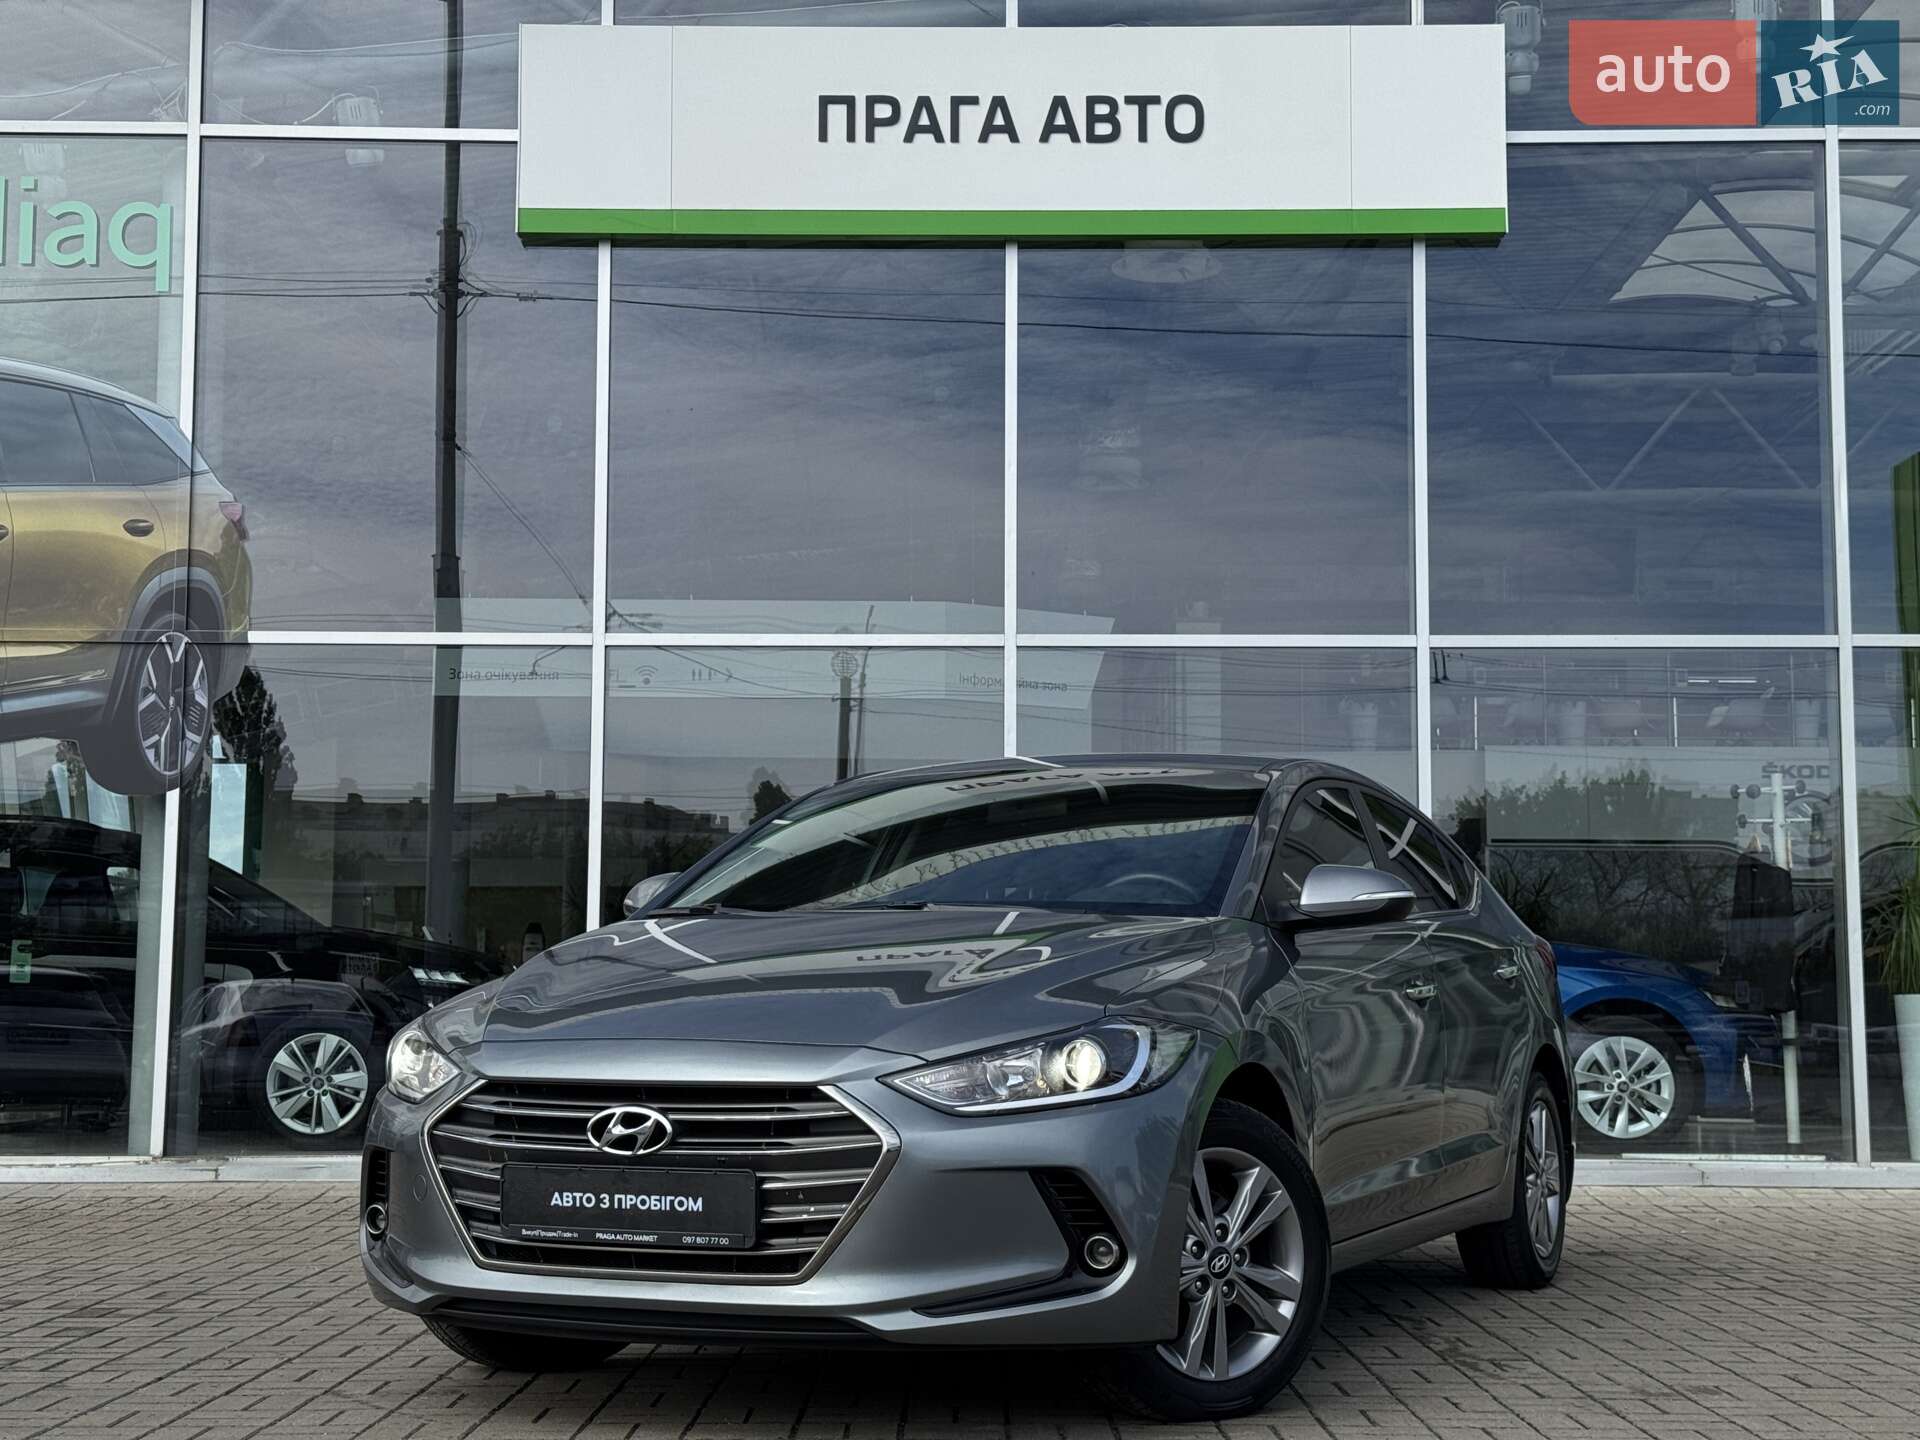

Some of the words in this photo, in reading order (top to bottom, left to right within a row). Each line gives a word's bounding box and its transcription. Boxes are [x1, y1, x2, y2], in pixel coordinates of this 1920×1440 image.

[818, 94, 1020, 144] ПРАГА
[1038, 94, 1206, 144] АВТО
[448, 667, 481, 681] Зона
[484, 668, 560, 683] очікування
[959, 671, 1039, 690] Інформйна
[1761, 761, 1831, 780] ŠKOD
[550, 1191, 596, 1208] АВТО
[613, 1194, 703, 1212] ПРОБІГОМ
[594, 1232, 616, 1240] PRAGA
[616, 1233, 633, 1241] AUTO
[633, 1234, 658, 1242] MARKET
[682, 1235, 695, 1244] 097
[696, 1236, 709, 1244] 807
[710, 1237, 719, 1245] 77
[719, 1237, 729, 1245] 00
